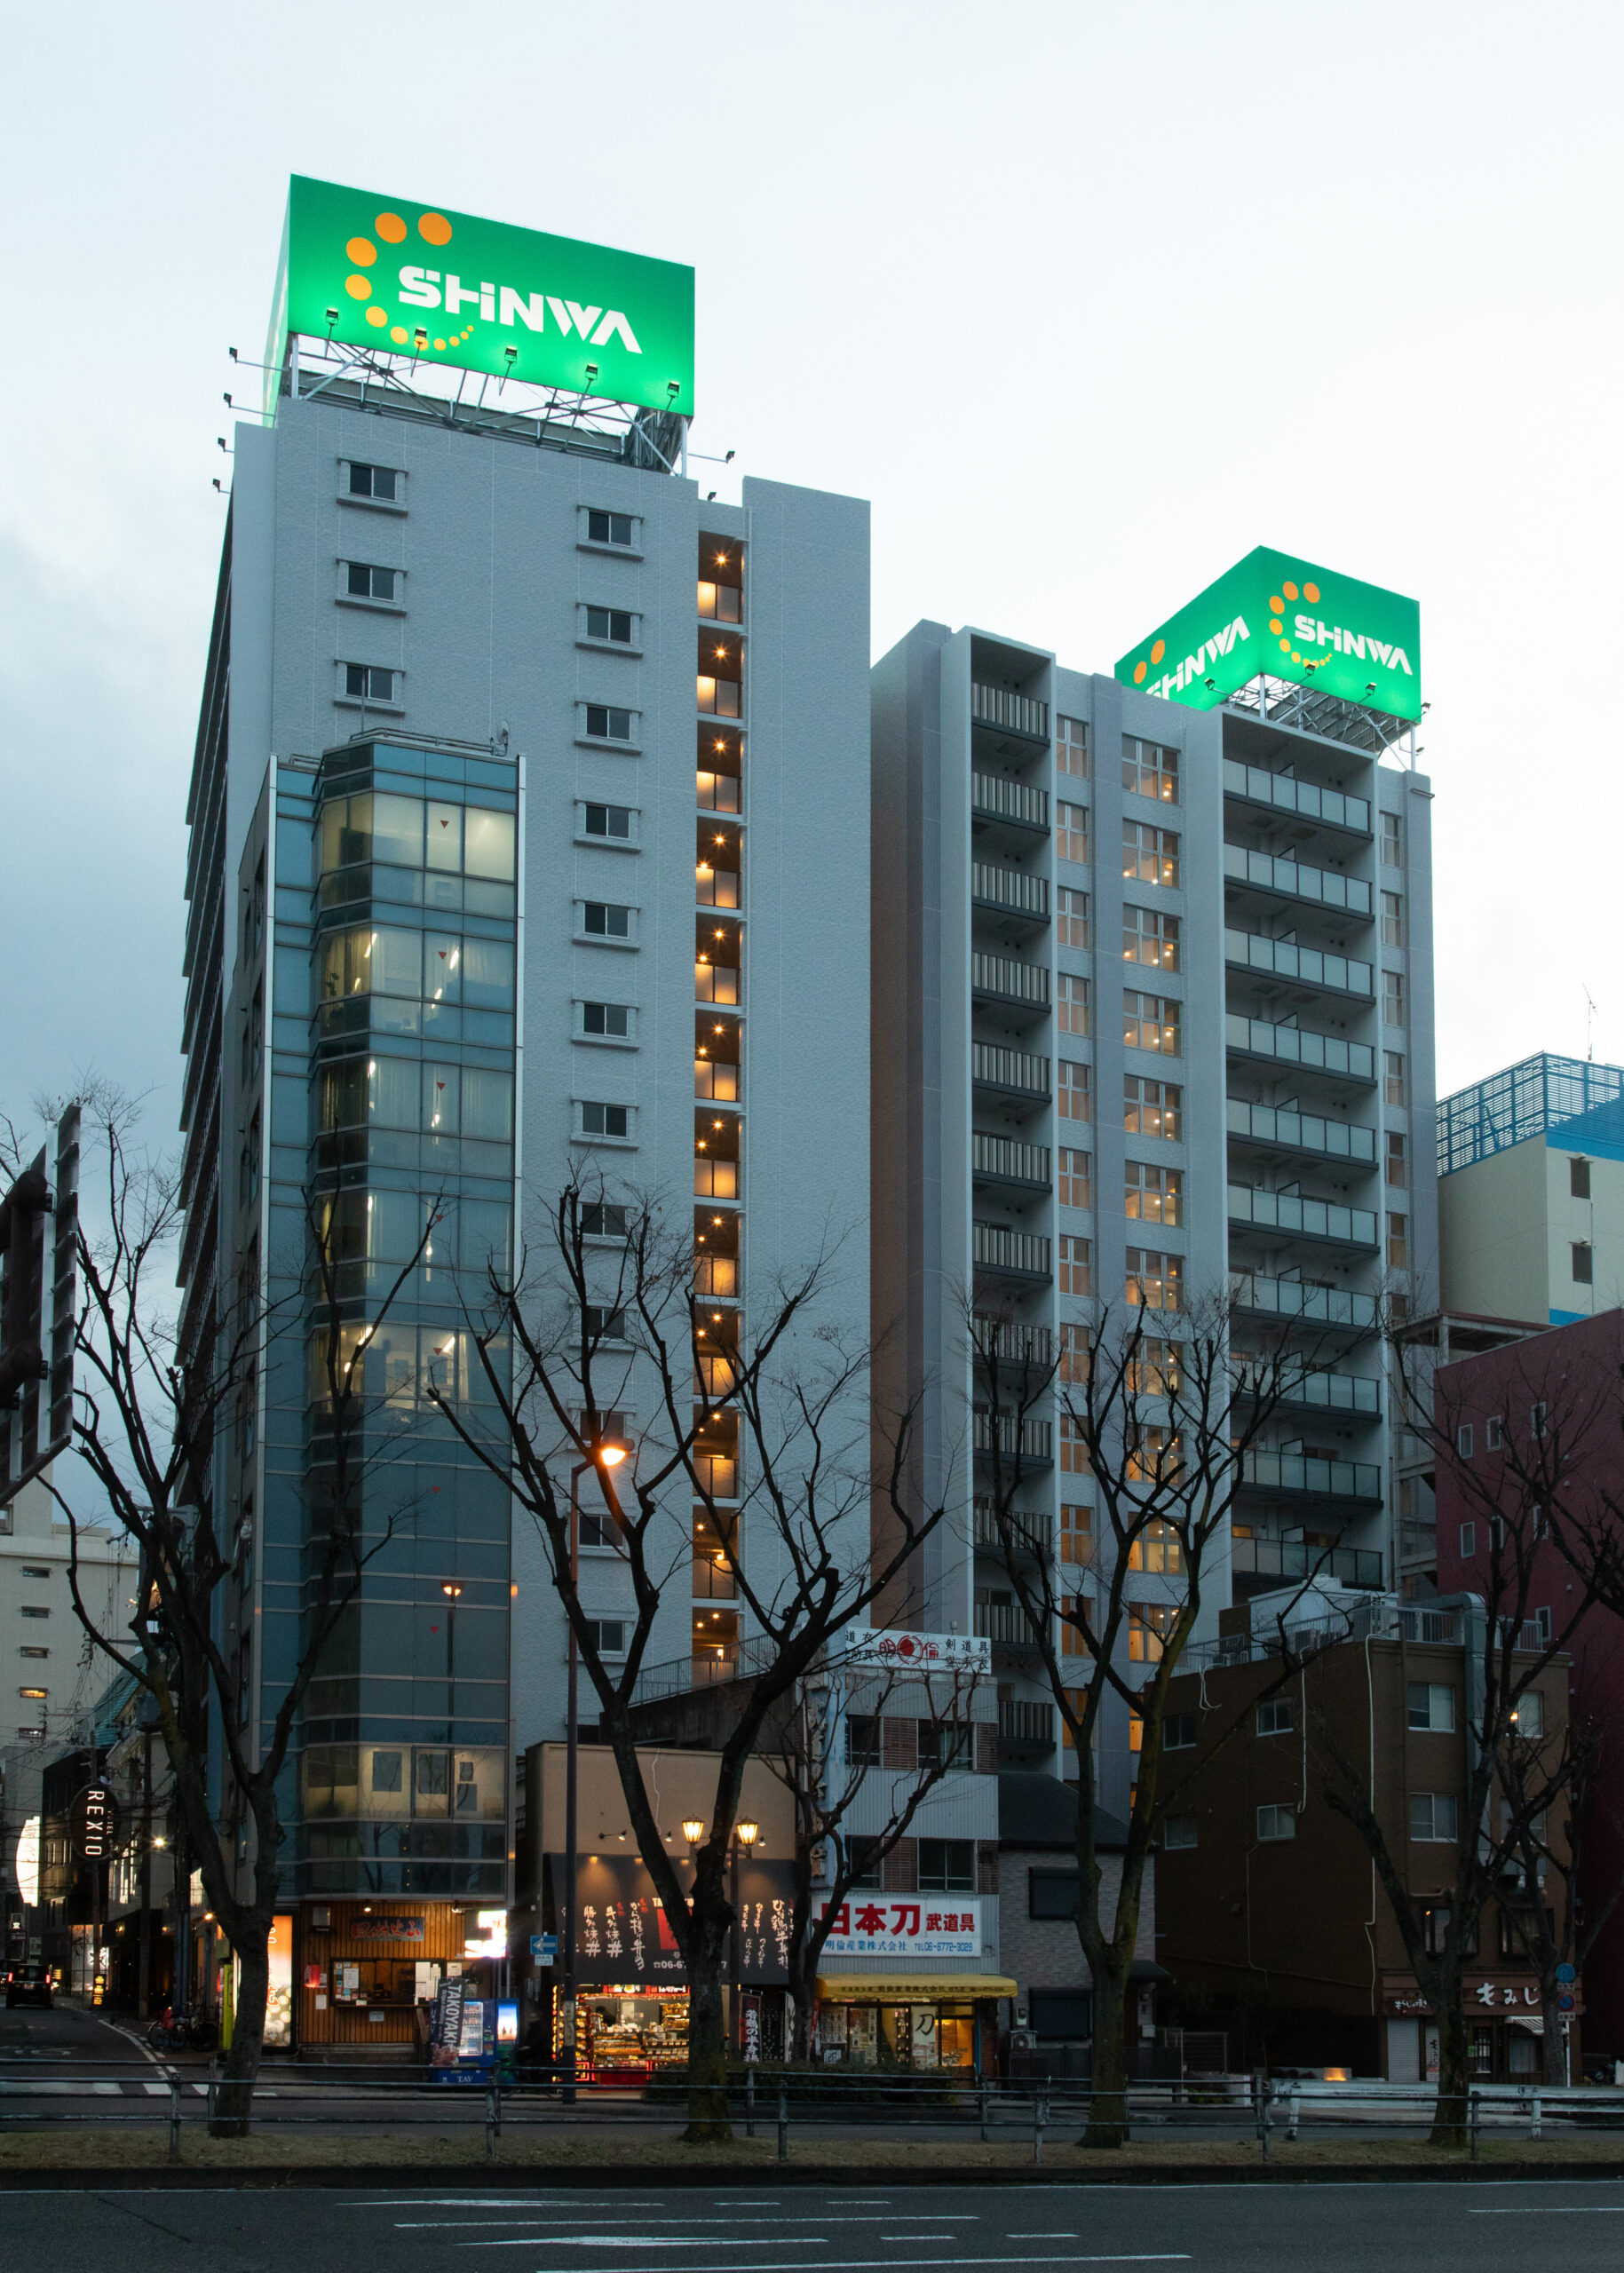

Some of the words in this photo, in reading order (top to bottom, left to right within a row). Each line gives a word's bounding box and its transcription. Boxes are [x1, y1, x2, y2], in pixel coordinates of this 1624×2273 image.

[945, 1638, 989, 1654] 剣道具
[85, 1790, 106, 1856] REXIO
[821, 1903, 921, 1936] 日本刀
[926, 1913, 975, 1932] 武道具
[825, 1940, 907, 1952] 明倫産業株式会社
[915, 2014, 936, 2036] 刀
